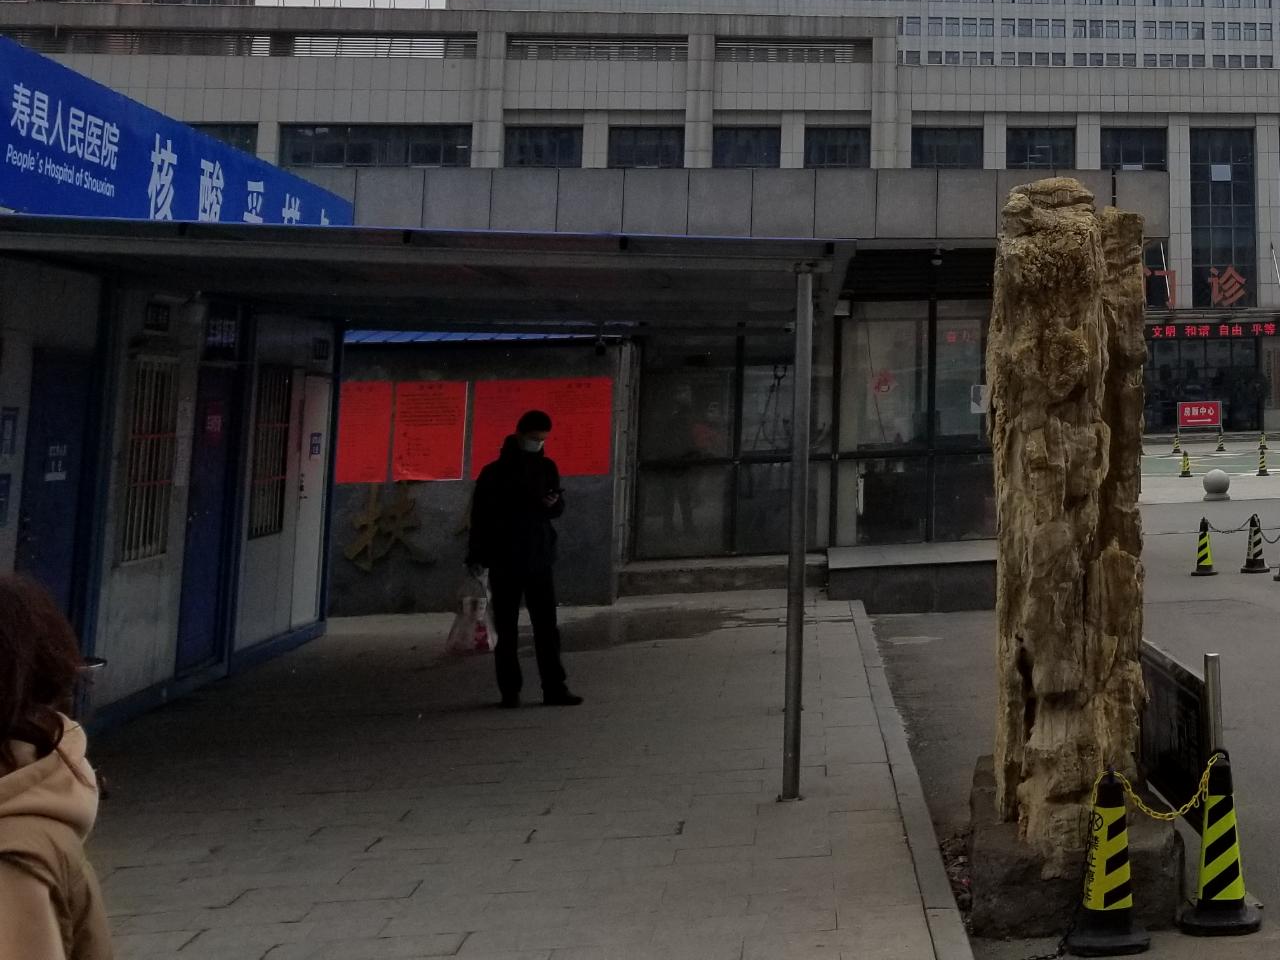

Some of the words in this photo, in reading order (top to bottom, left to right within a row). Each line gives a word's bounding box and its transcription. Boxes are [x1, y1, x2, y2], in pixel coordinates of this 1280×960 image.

[10, 82, 120, 171] 寿县人民医院
[44, 156, 75, 185] Hospital
[83, 171, 115, 198] Shouxian
[1219, 323, 1242, 336] 自由
